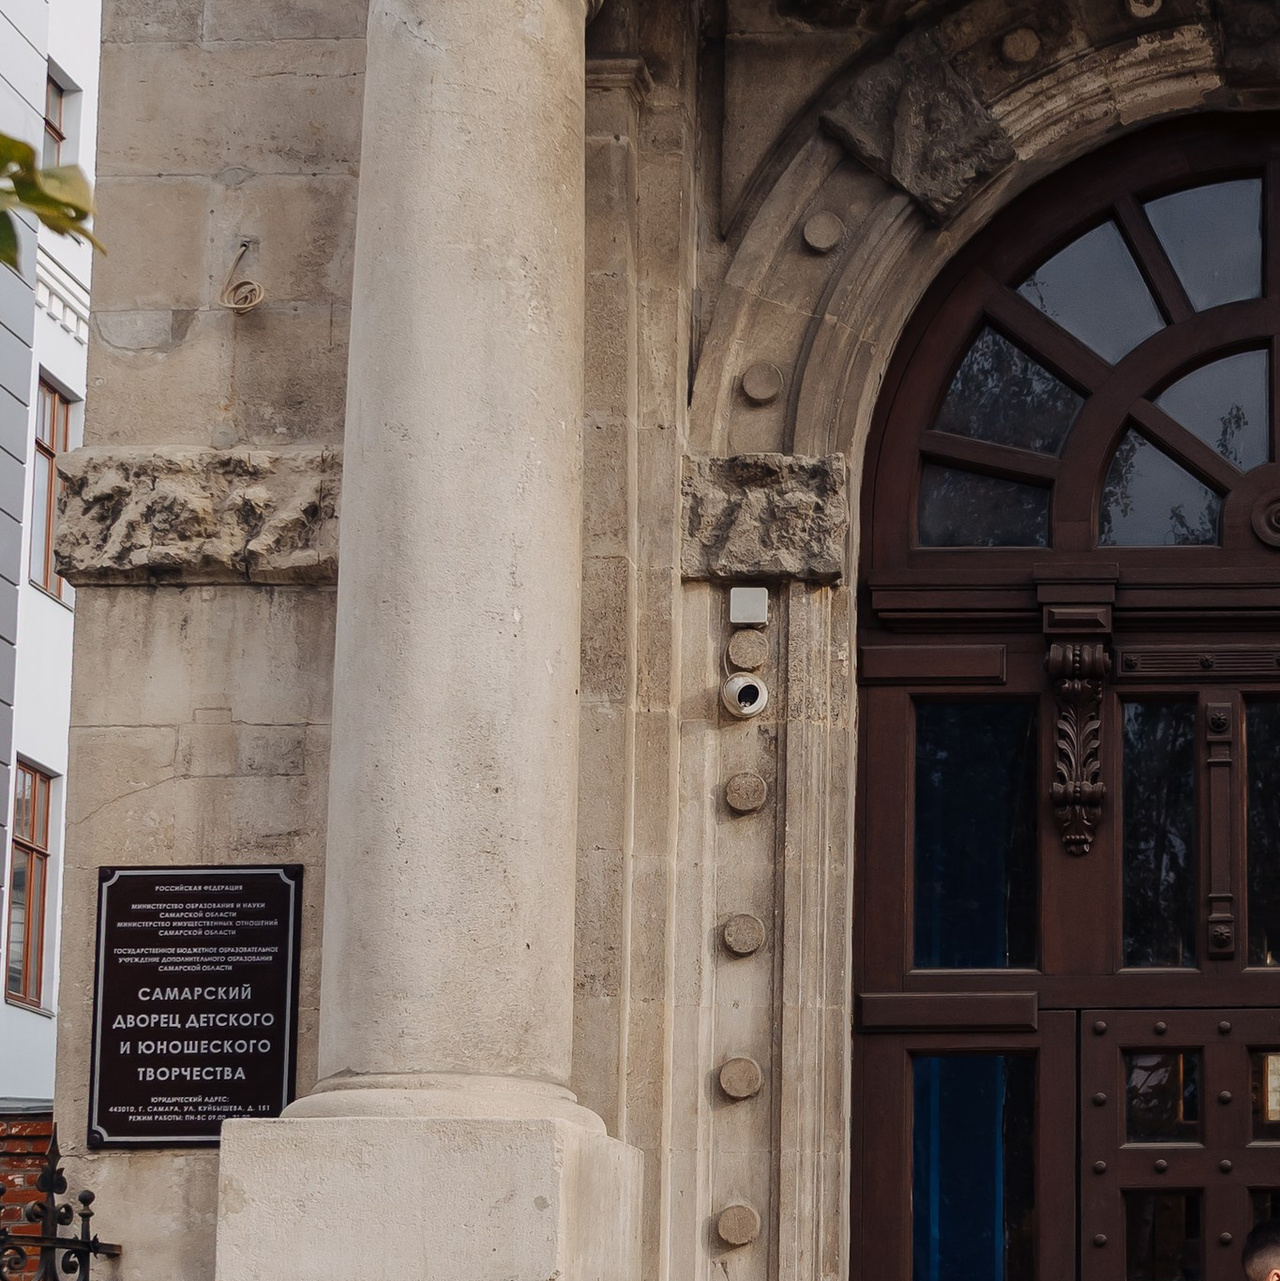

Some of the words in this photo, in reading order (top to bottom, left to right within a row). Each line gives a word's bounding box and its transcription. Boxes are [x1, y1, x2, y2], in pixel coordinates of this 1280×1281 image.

[155, 884, 202, 892] РОССИЙСКАЯ
[159, 910, 203, 918] САМАРСКОЙ
[205, 910, 236, 918] ОБЛАСТИ
[116, 920, 171, 928] МИНИСТЕРСТВО
[158, 928, 202, 936] САМАРСКОЙ
[204, 928, 236, 936] ОБЛАСТИ
[218, 946, 278, 954] ОБРАЗОВАТЕЛЬНОЕ
[158, 963, 201, 971] САМАРСКОЙ
[202, 963, 232, 971] ОБЛАСТИ
[138, 983, 251, 1001] САМАРСКИЙ
[112, 1013, 181, 1029] ДВОРЕЦ
[185, 1012, 274, 1028] ДЕТСКОГО
[120, 1040, 130, 1054] И
[138, 1039, 270, 1054] ЮНОШЕСКОГО
[137, 1066, 246, 1081] ТВОРЧЕСТВА
[151, 1095, 202, 1104] ЮРИДИЧЕСКИЙ
[204, 1095, 229, 1103] АДРЕС:
[147, 1105, 181, 1113] САМАРА,
